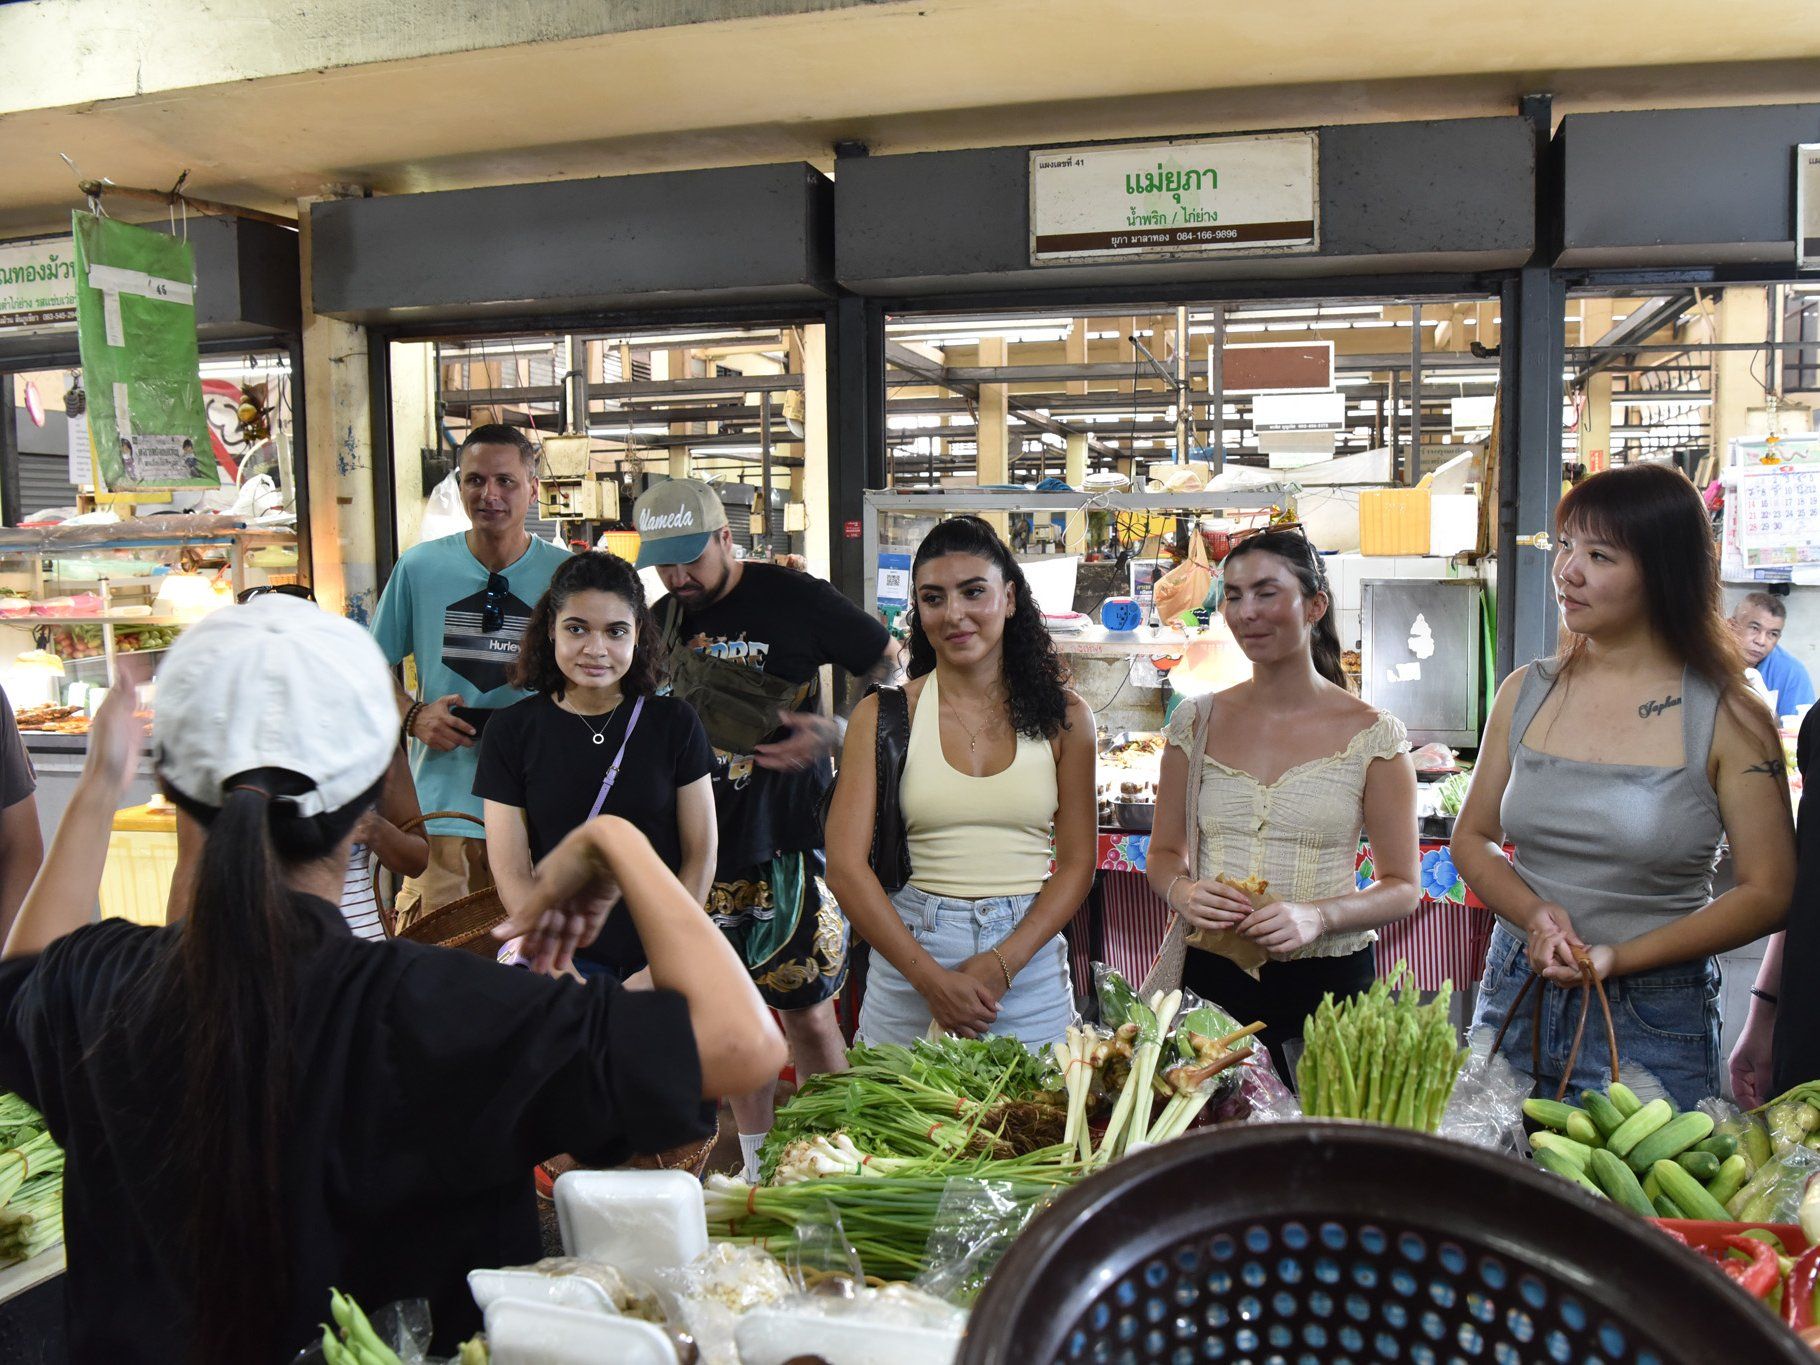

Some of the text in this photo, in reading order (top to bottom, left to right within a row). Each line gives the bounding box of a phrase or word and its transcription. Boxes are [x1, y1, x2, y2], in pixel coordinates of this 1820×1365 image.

[1126, 163, 1217, 204] แม่ยุภา
[1127, 206, 1166, 226] น้ำพริก
[1181, 206, 1218, 223] ไก่ย่าง
[1111, 236, 1128, 248] ยุภา
[1176, 229, 1237, 241] 084-166-9896
